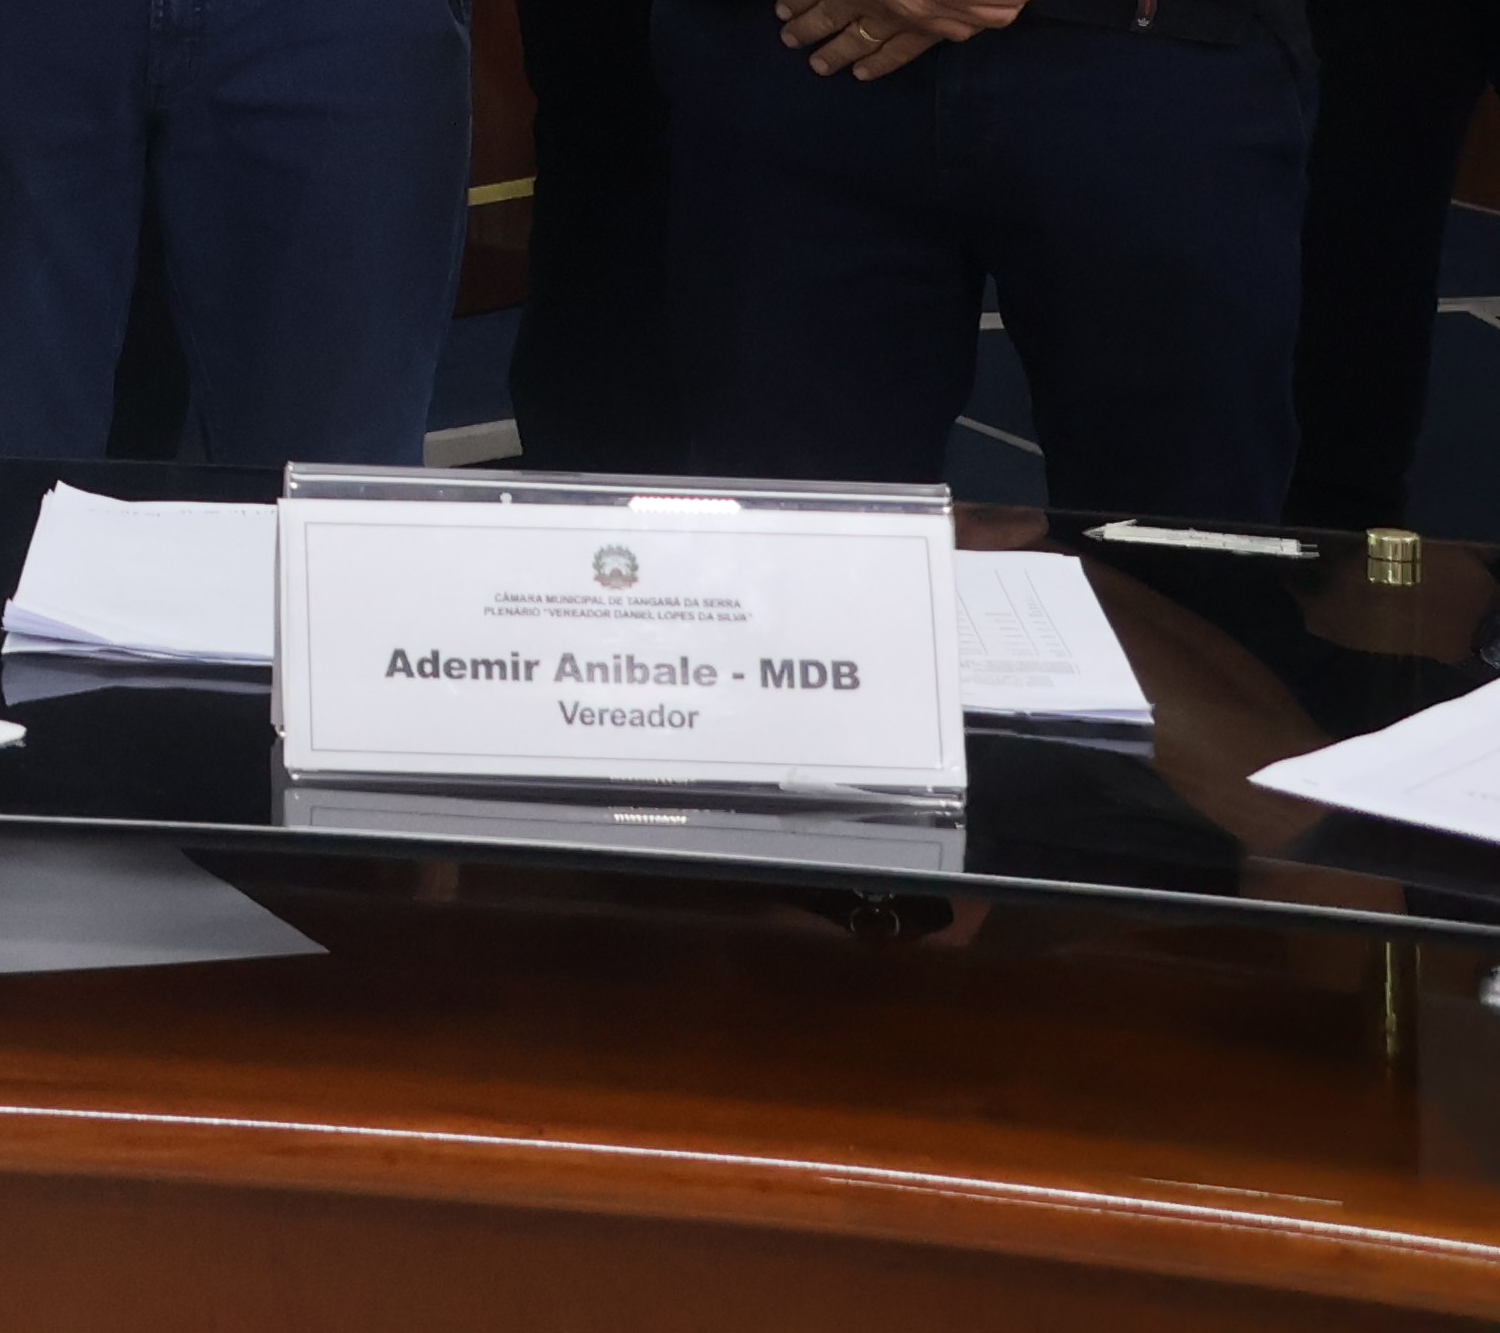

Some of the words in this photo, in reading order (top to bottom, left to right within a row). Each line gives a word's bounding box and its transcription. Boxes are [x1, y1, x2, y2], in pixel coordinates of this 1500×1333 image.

[385, 649, 540, 681] Ademir
[554, 653, 717, 686] Anibale
[760, 658, 860, 690] MDB
[558, 700, 699, 729] Vereador
